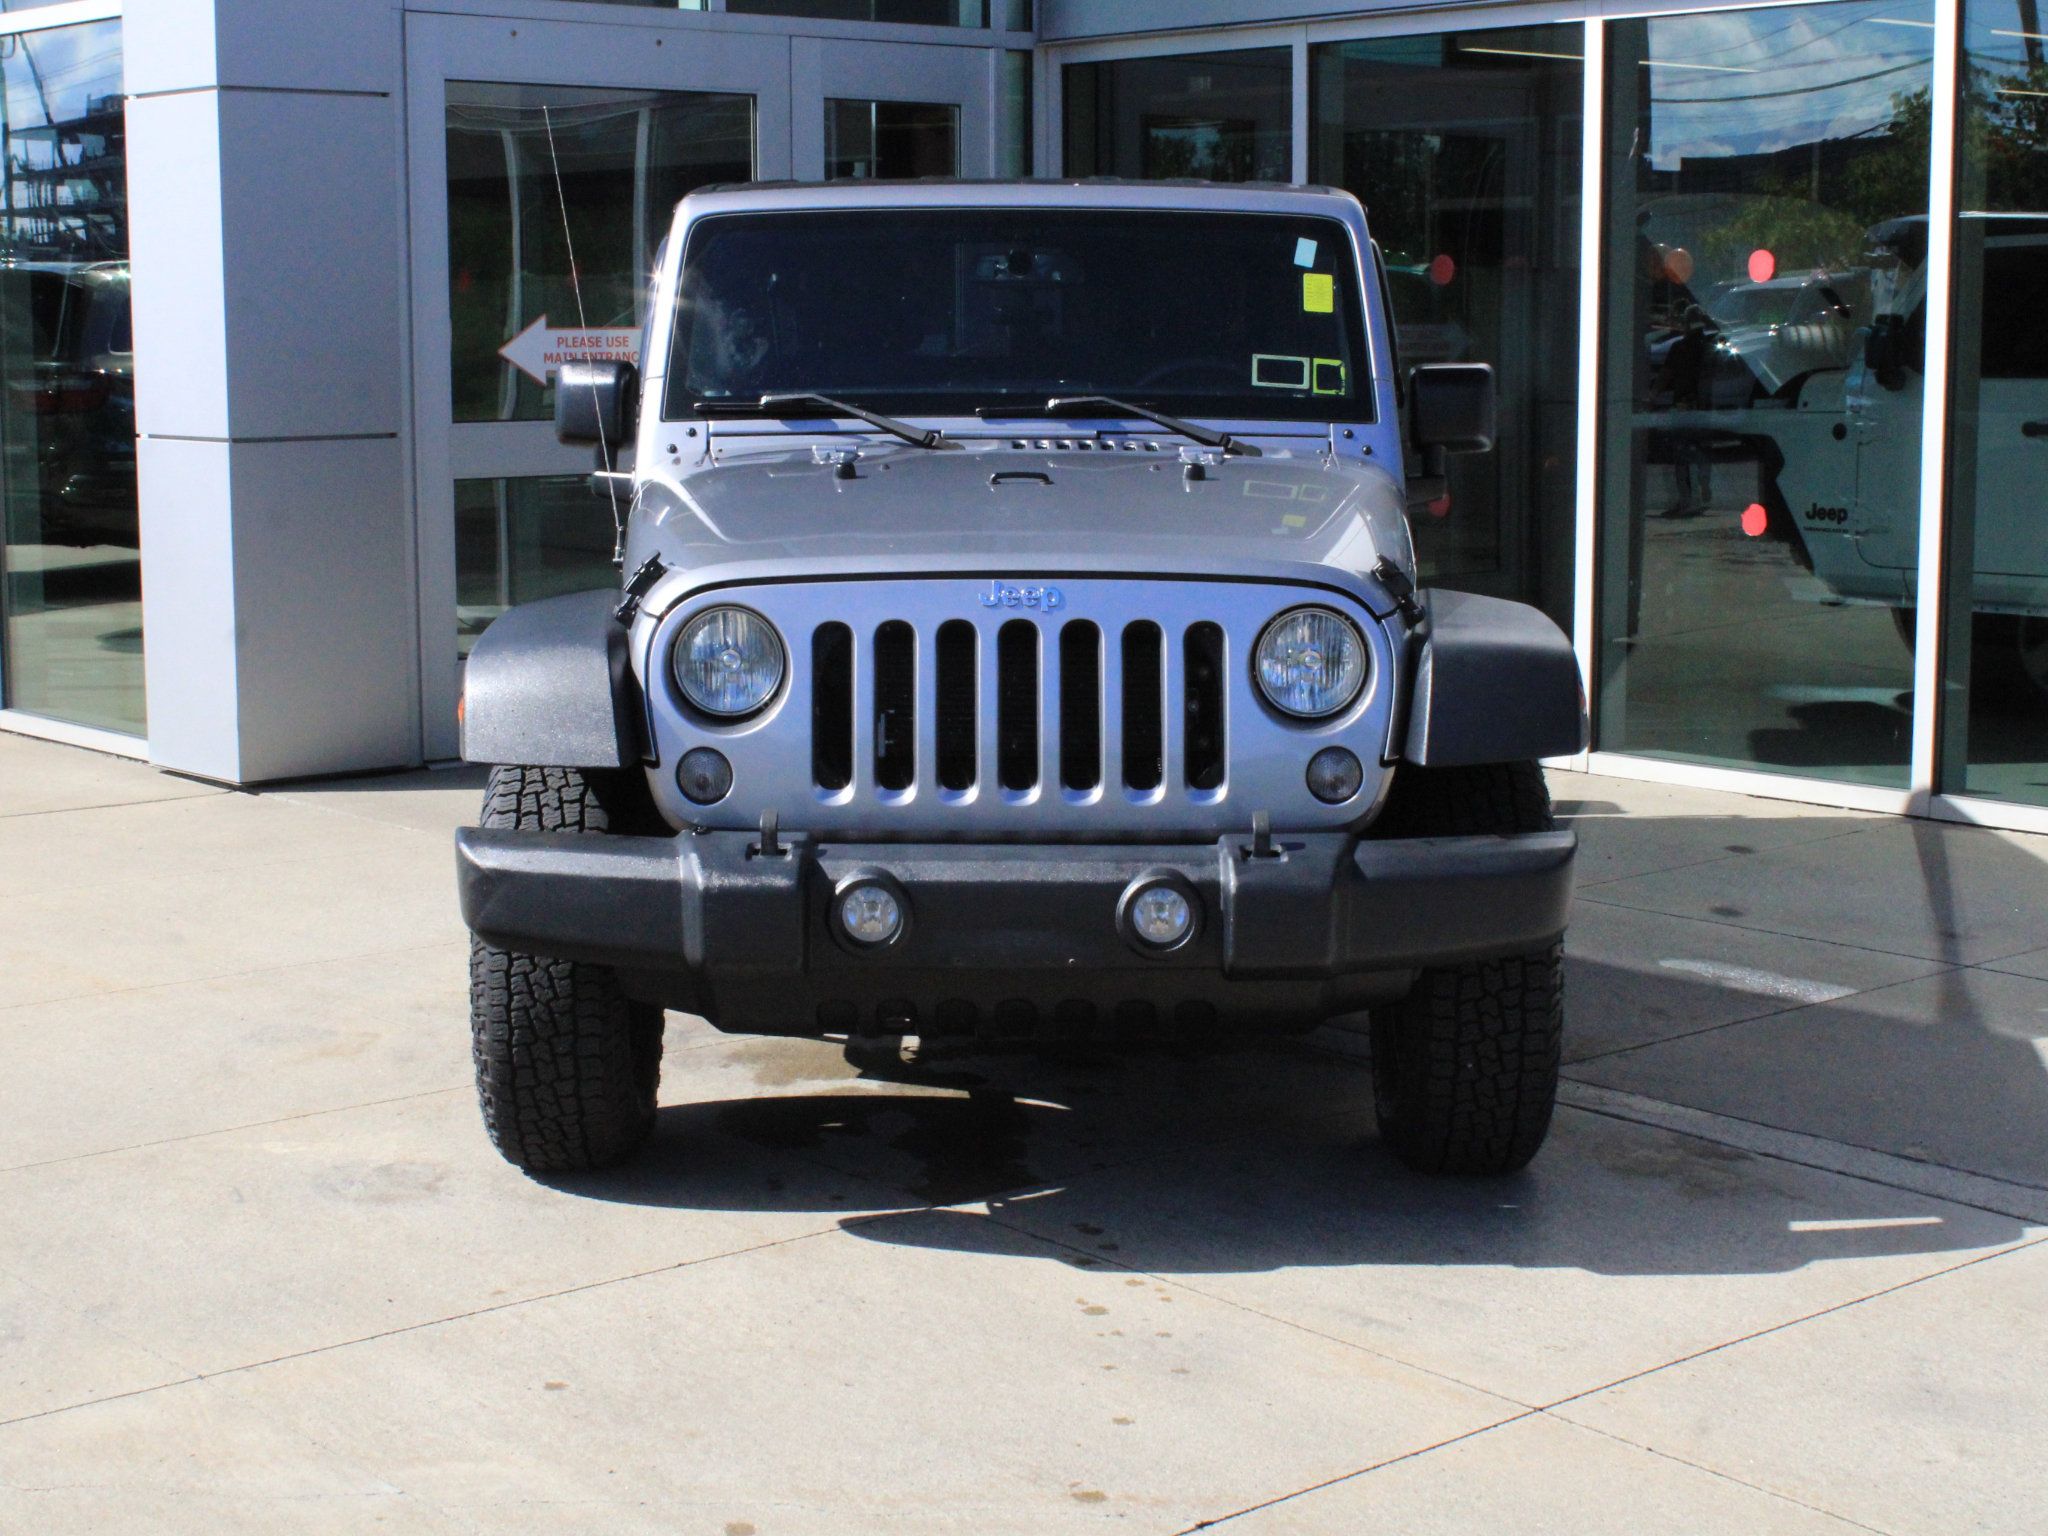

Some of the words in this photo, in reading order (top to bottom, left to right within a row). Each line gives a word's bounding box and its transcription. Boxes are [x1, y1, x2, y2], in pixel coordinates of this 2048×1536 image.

[557, 336, 602, 348] PLEASE
[606, 336, 629, 348] USE
[543, 351, 577, 363] MAIN
[581, 351, 640, 364] ENTRANC
[1805, 502, 1849, 525] Jeep
[977, 579, 1062, 612] Jeep
